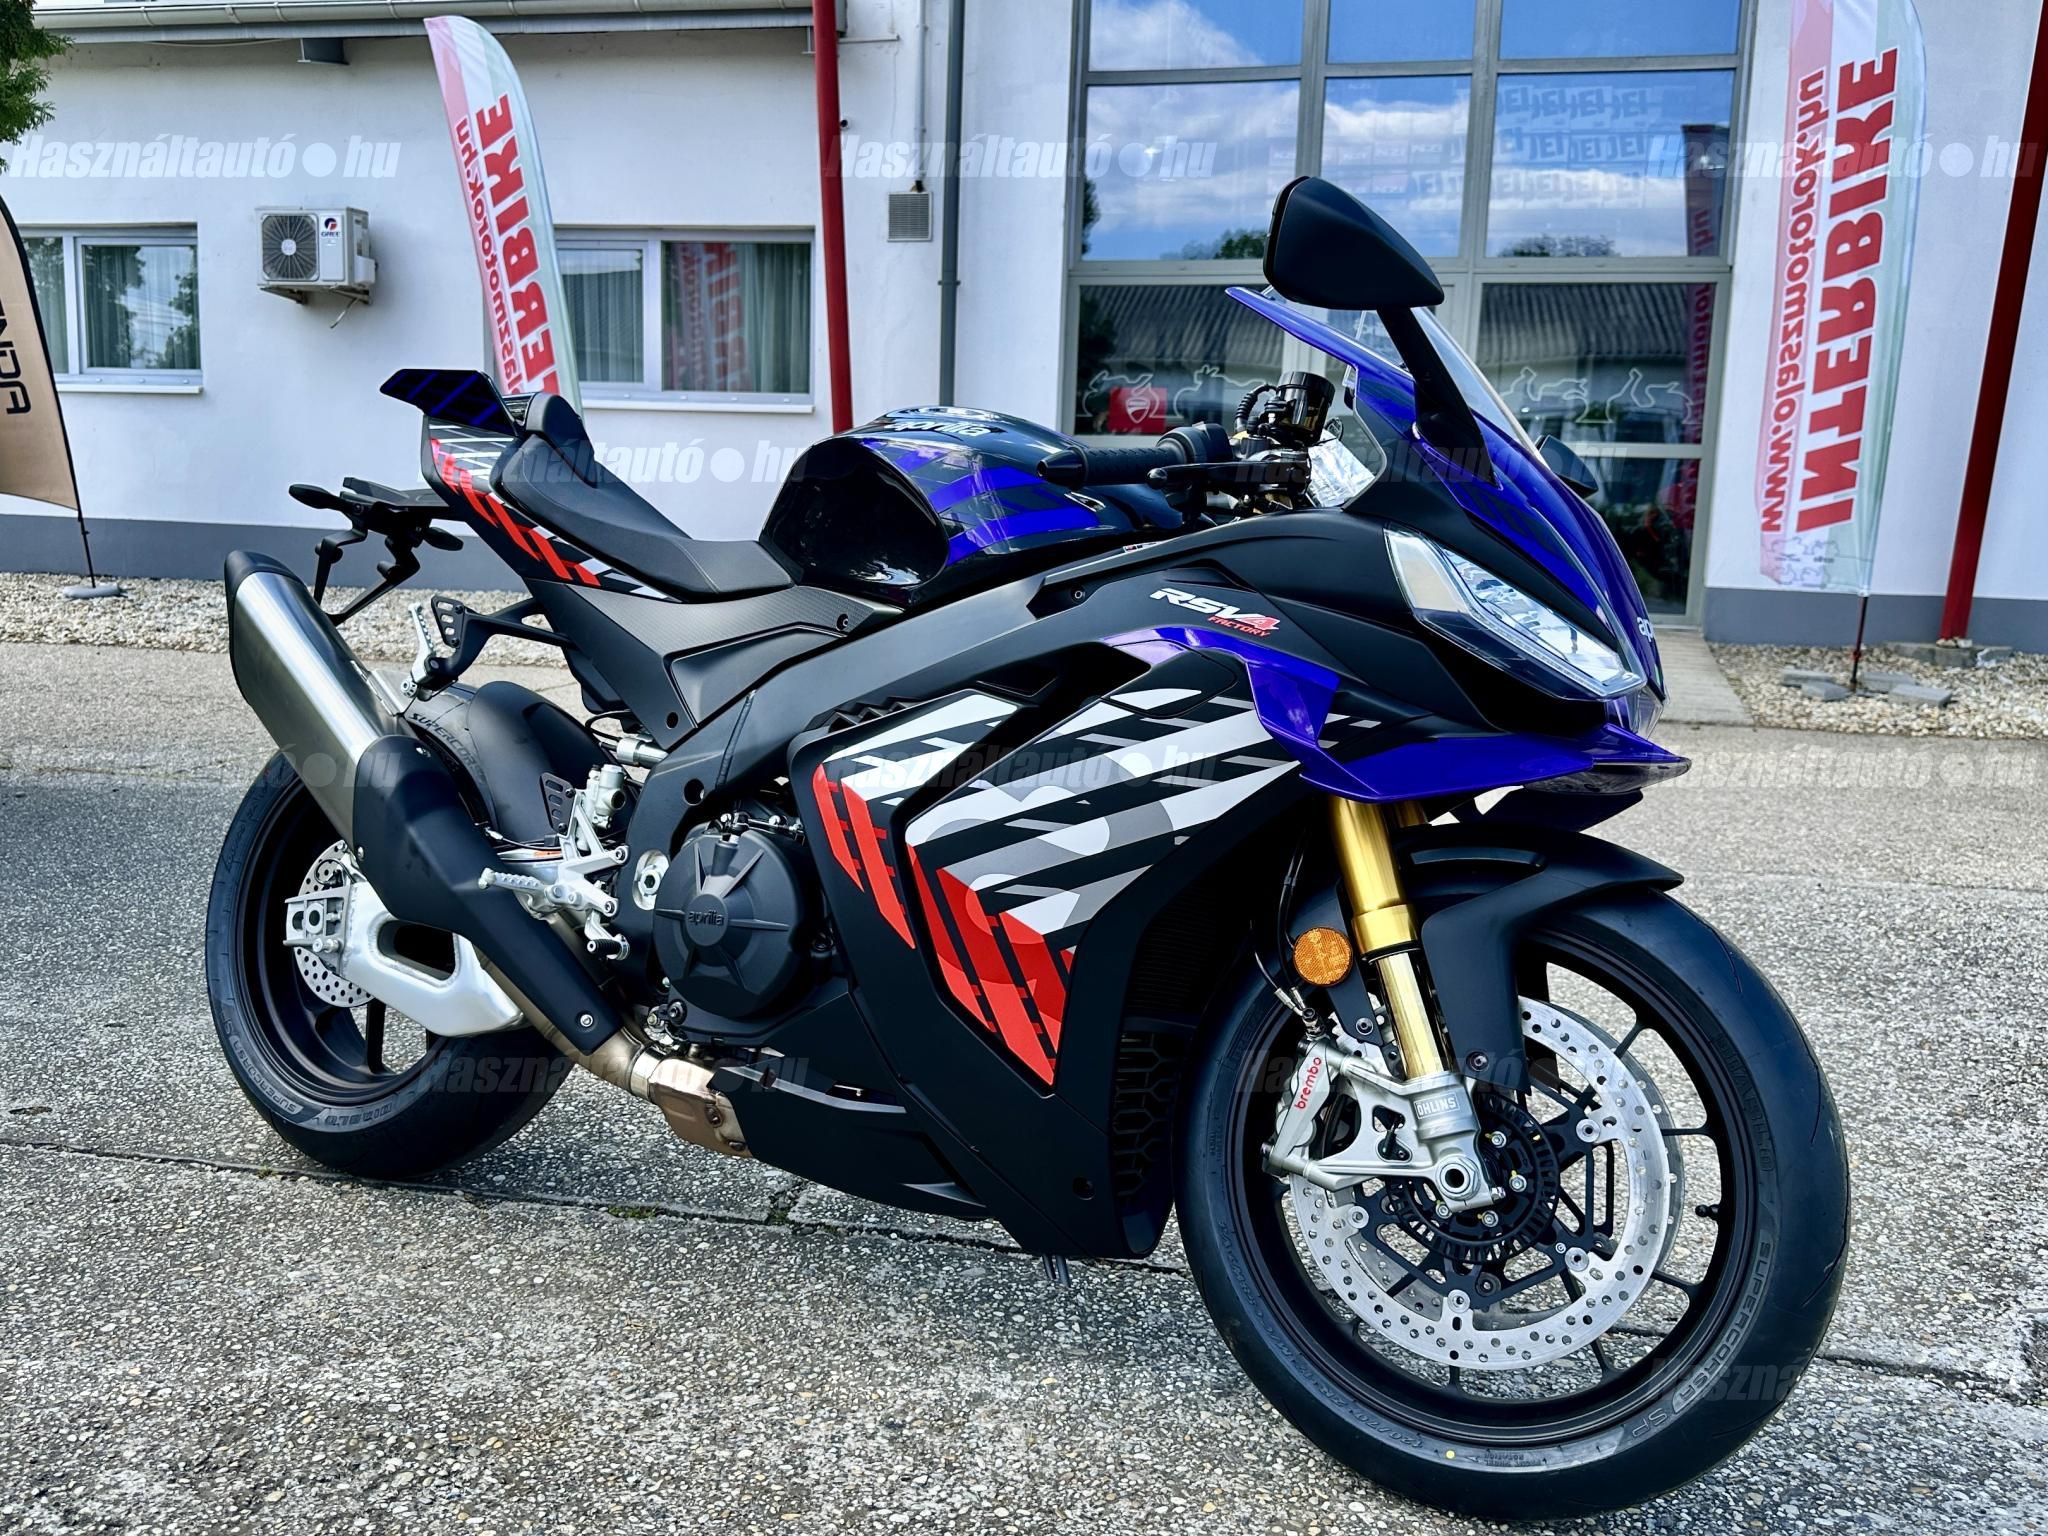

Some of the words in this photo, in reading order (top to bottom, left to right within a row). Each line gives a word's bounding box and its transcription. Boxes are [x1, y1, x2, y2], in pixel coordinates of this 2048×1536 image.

[1149, 587, 1281, 630] RSV4
[1207, 615, 1271, 637] FACTORY
[688, 909, 725, 927] aprilia
[233, 1040, 297, 1114] SUPERCORSA
[1294, 1056, 1322, 1110] brembo
[1680, 1241, 1772, 1402] SUPERCORSA
[1632, 1407, 1668, 1439] SP
